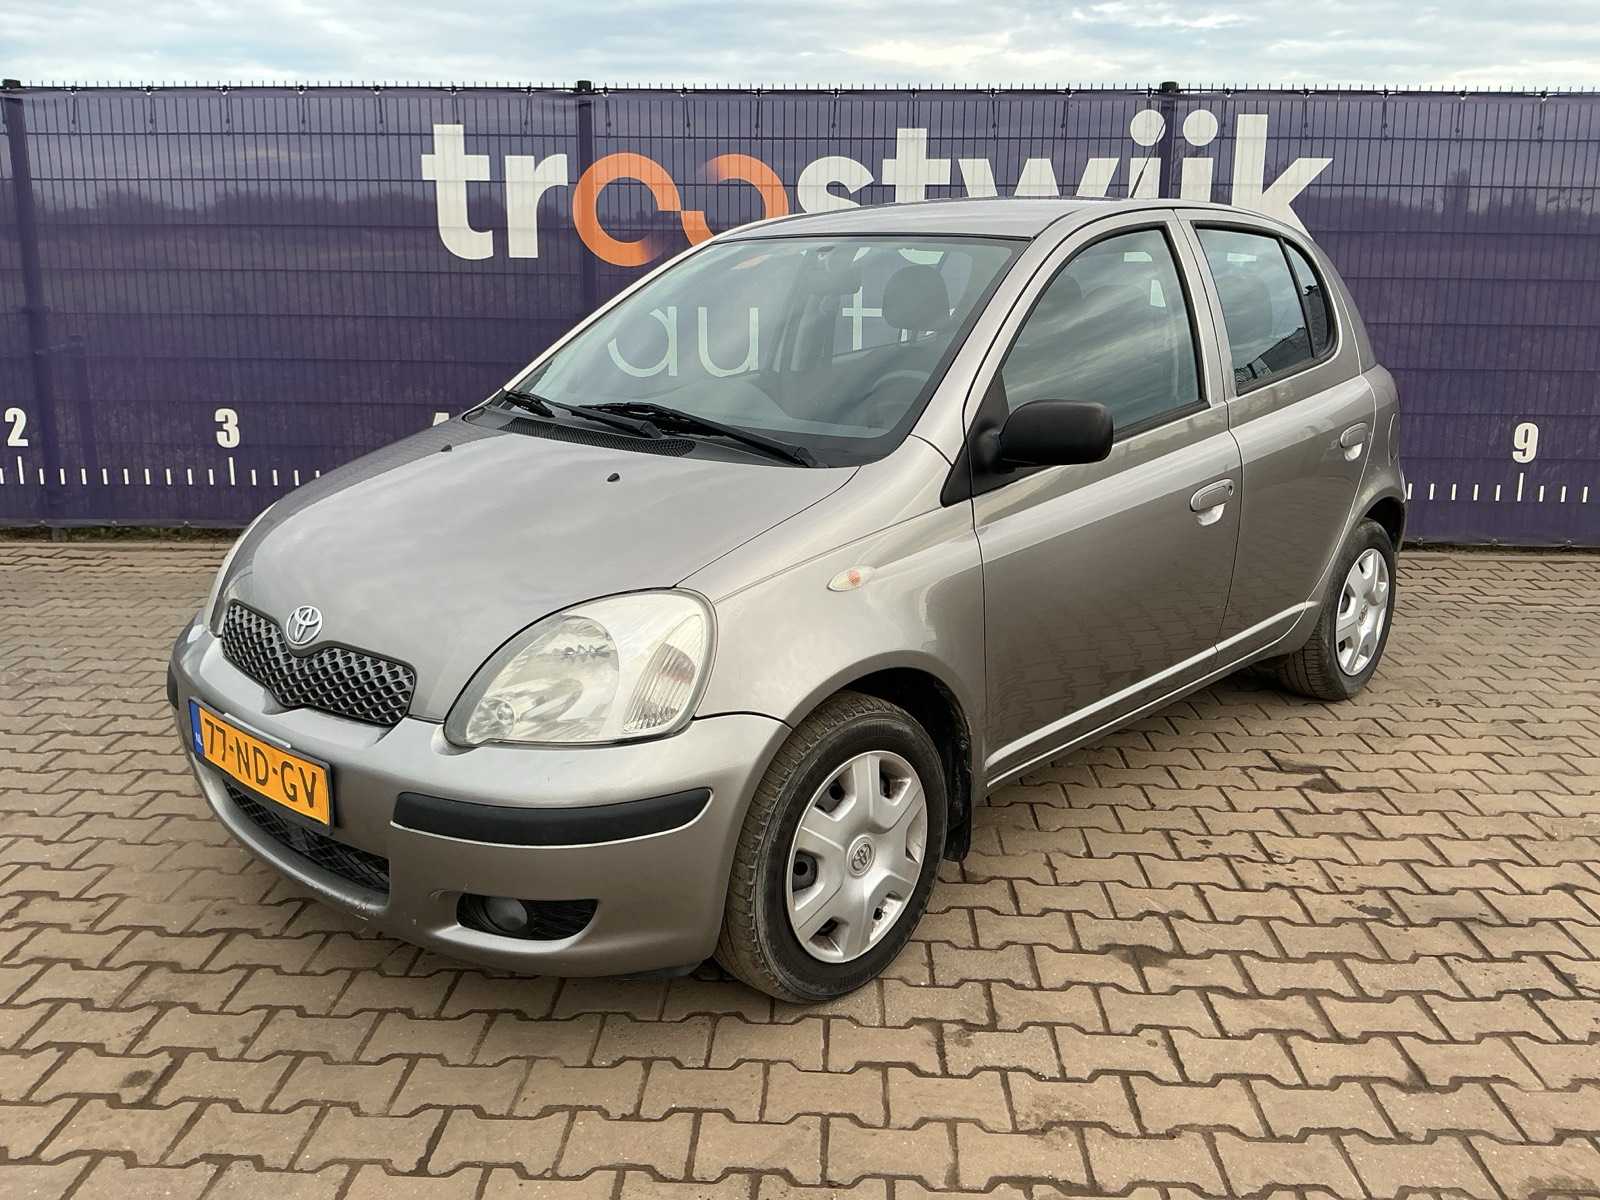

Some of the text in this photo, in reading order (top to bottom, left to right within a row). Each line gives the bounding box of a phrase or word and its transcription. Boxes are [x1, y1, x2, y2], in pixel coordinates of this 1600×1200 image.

[4, 407, 29, 447] 2
[214, 408, 241, 448] 3
[1512, 422, 1539, 464] 9
[204, 718, 317, 809] 77-ND-GV
